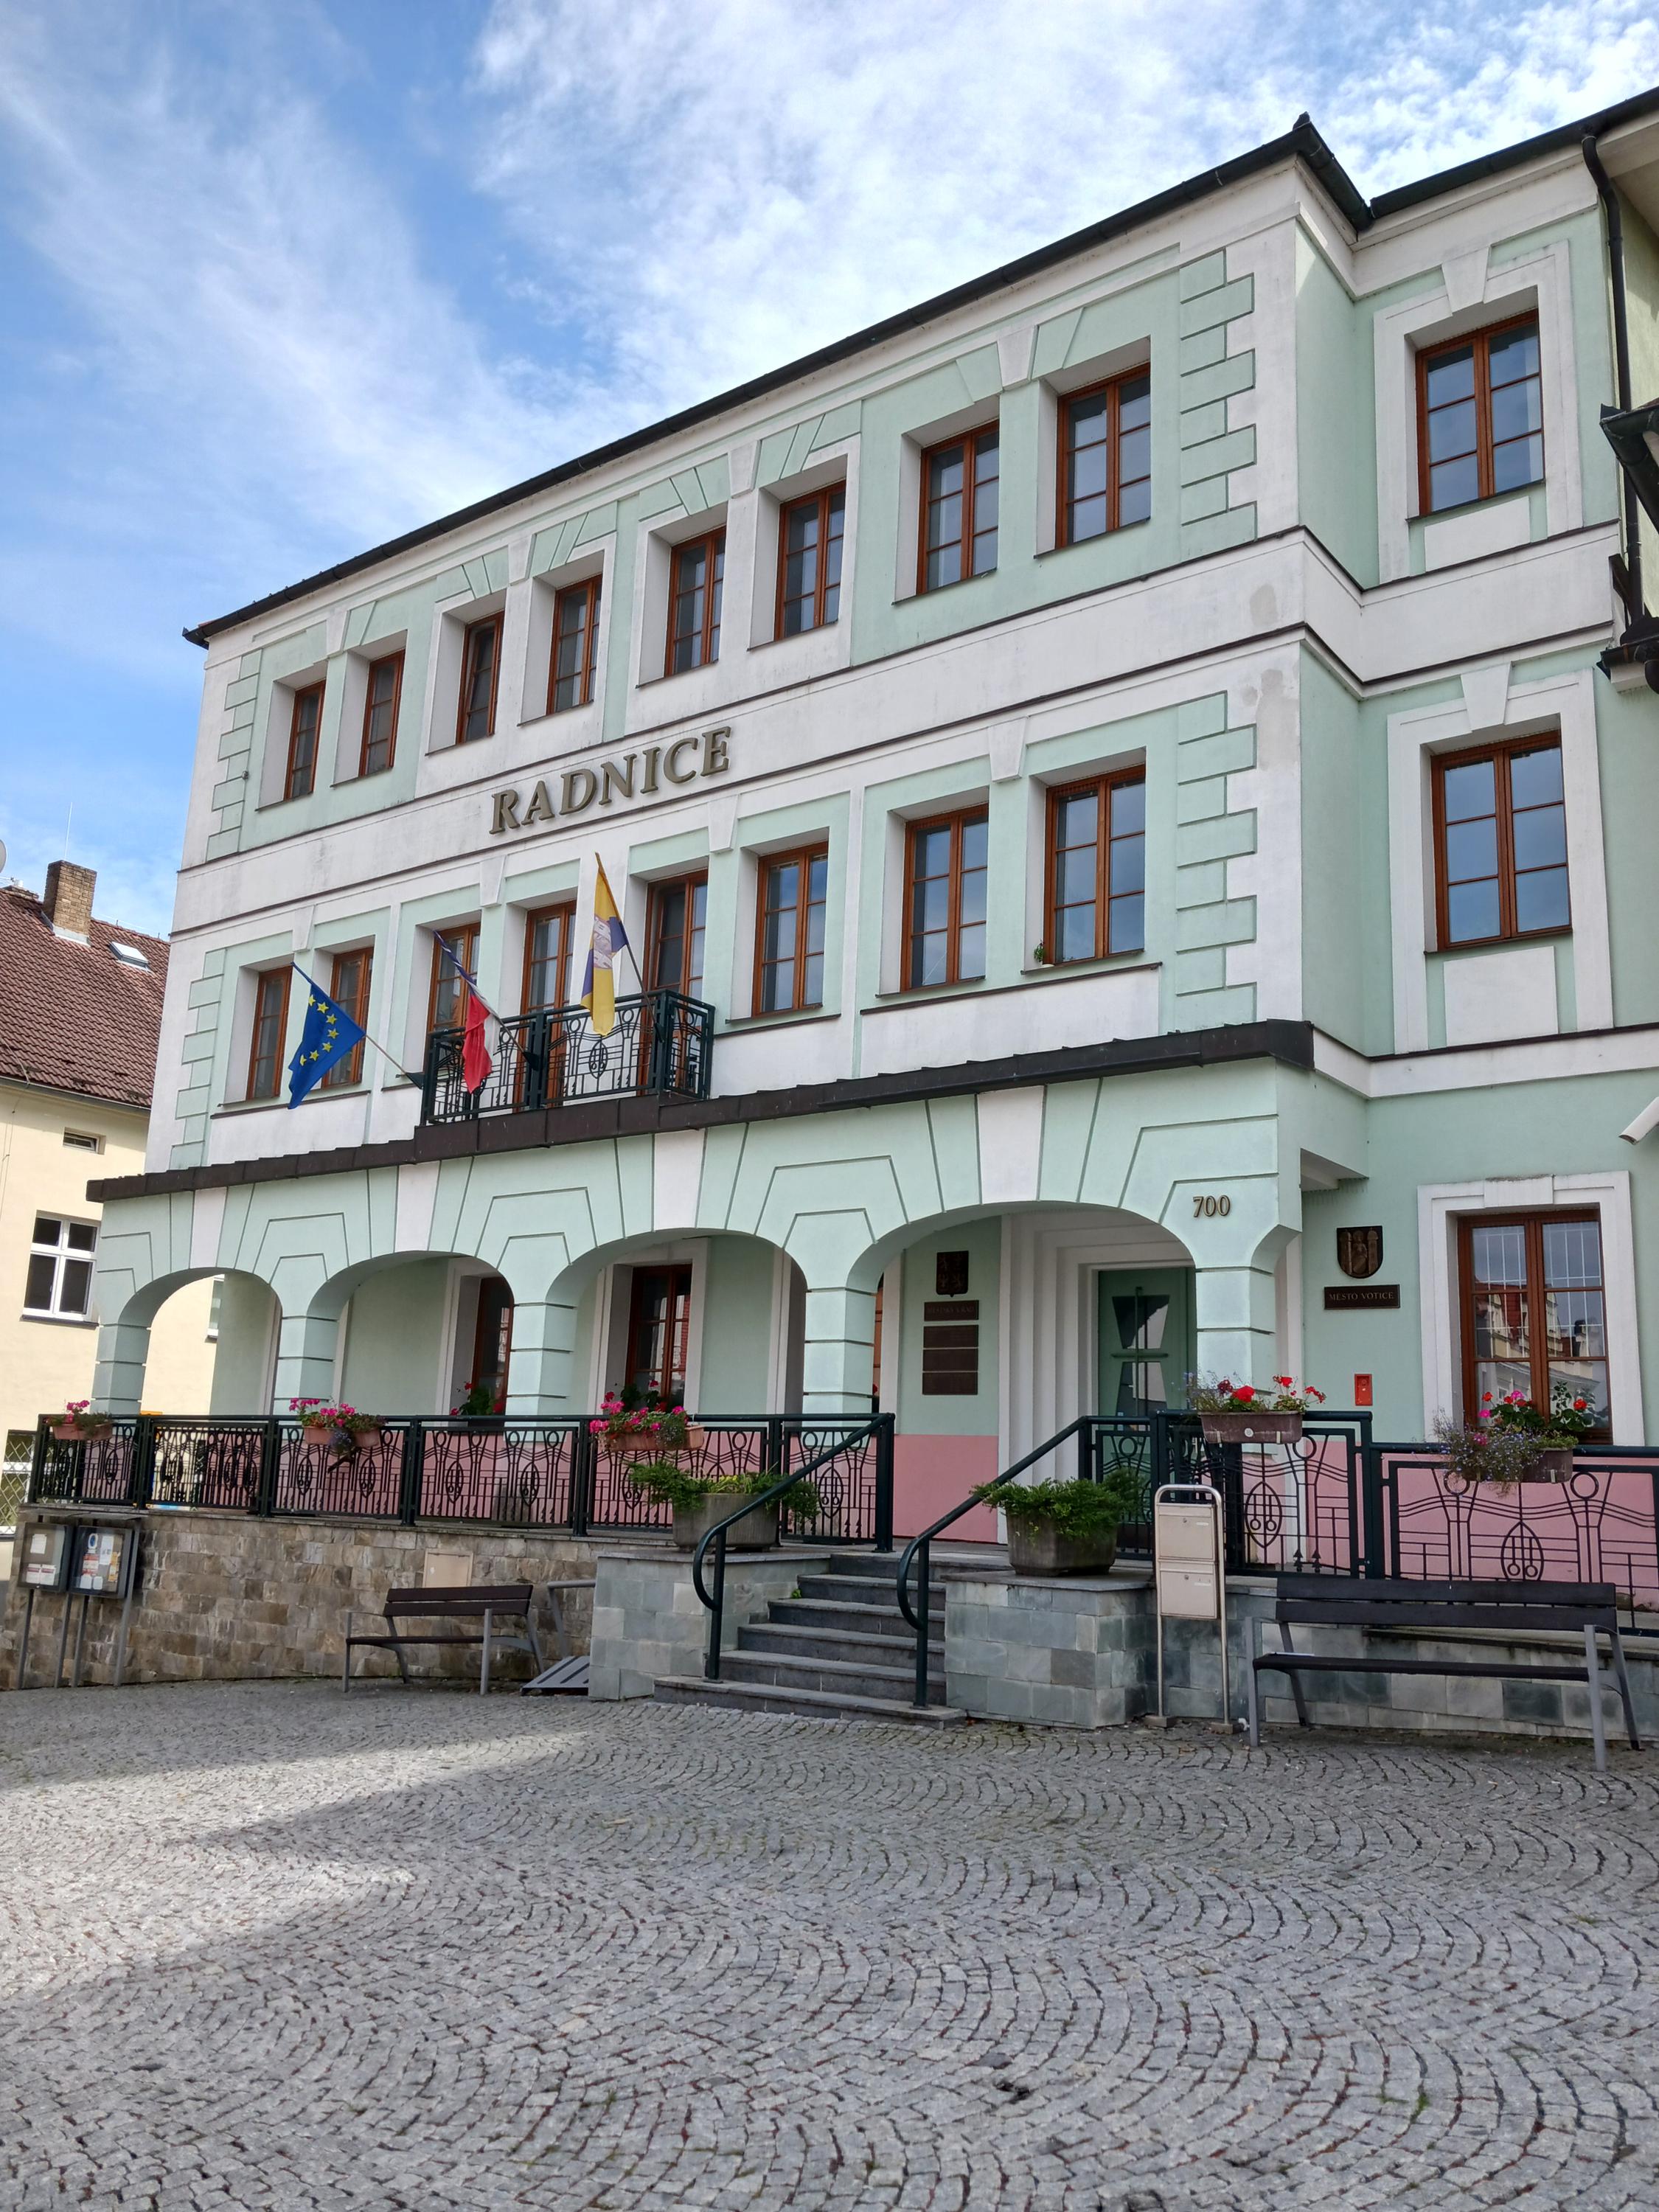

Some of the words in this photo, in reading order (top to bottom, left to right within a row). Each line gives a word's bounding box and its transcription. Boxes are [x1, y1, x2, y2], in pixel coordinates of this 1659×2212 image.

[489, 726, 731, 835] RADNICE
[1192, 1194, 1231, 1217] 700
[1360, 1291, 1394, 1299] VOTICE
